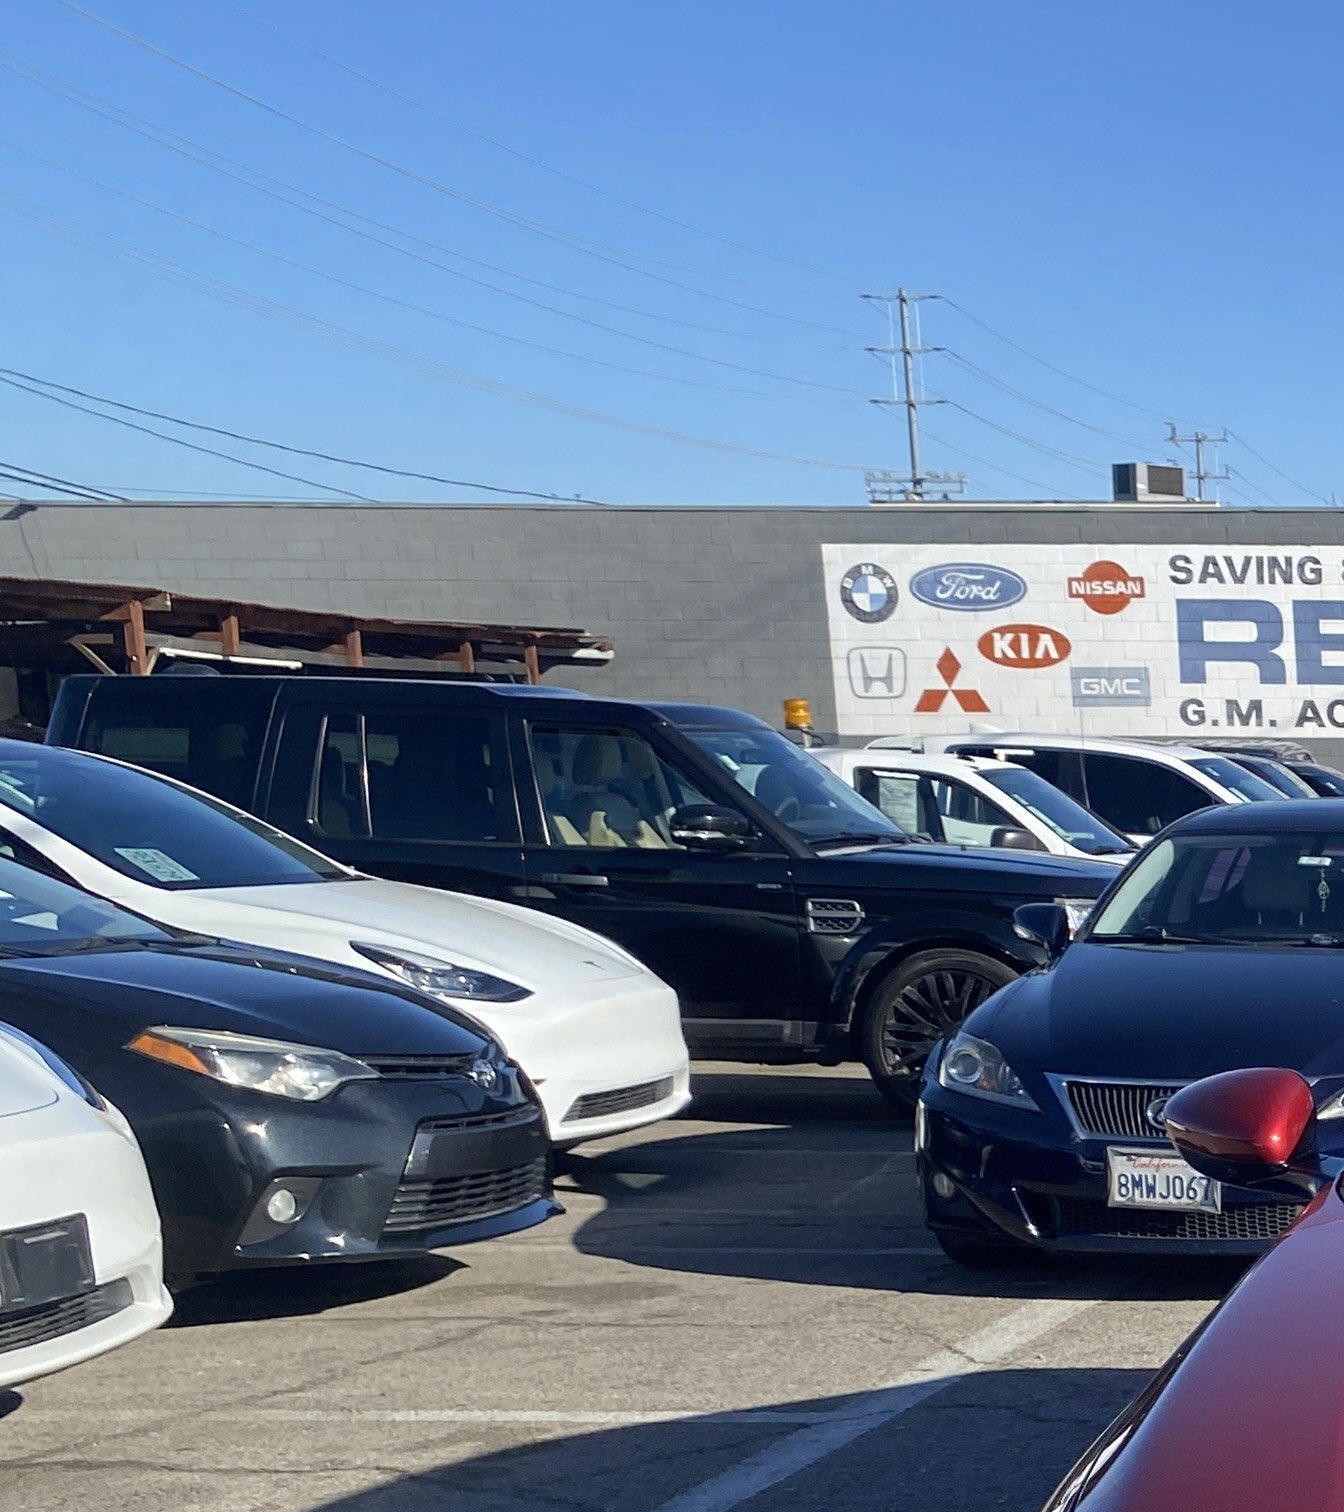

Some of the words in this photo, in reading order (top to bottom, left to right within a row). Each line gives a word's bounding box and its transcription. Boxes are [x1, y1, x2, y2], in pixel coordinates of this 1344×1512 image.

[1169, 555, 1323, 586] SAVING
[936, 571, 1001, 601] Ford
[1070, 580, 1142, 595] NISSAN
[991, 632, 1060, 660] KIA
[1080, 677, 1141, 695] GMC
[1179, 698, 1278, 728] G.M.
[1117, 1173, 1211, 1201] 8MWJ067
